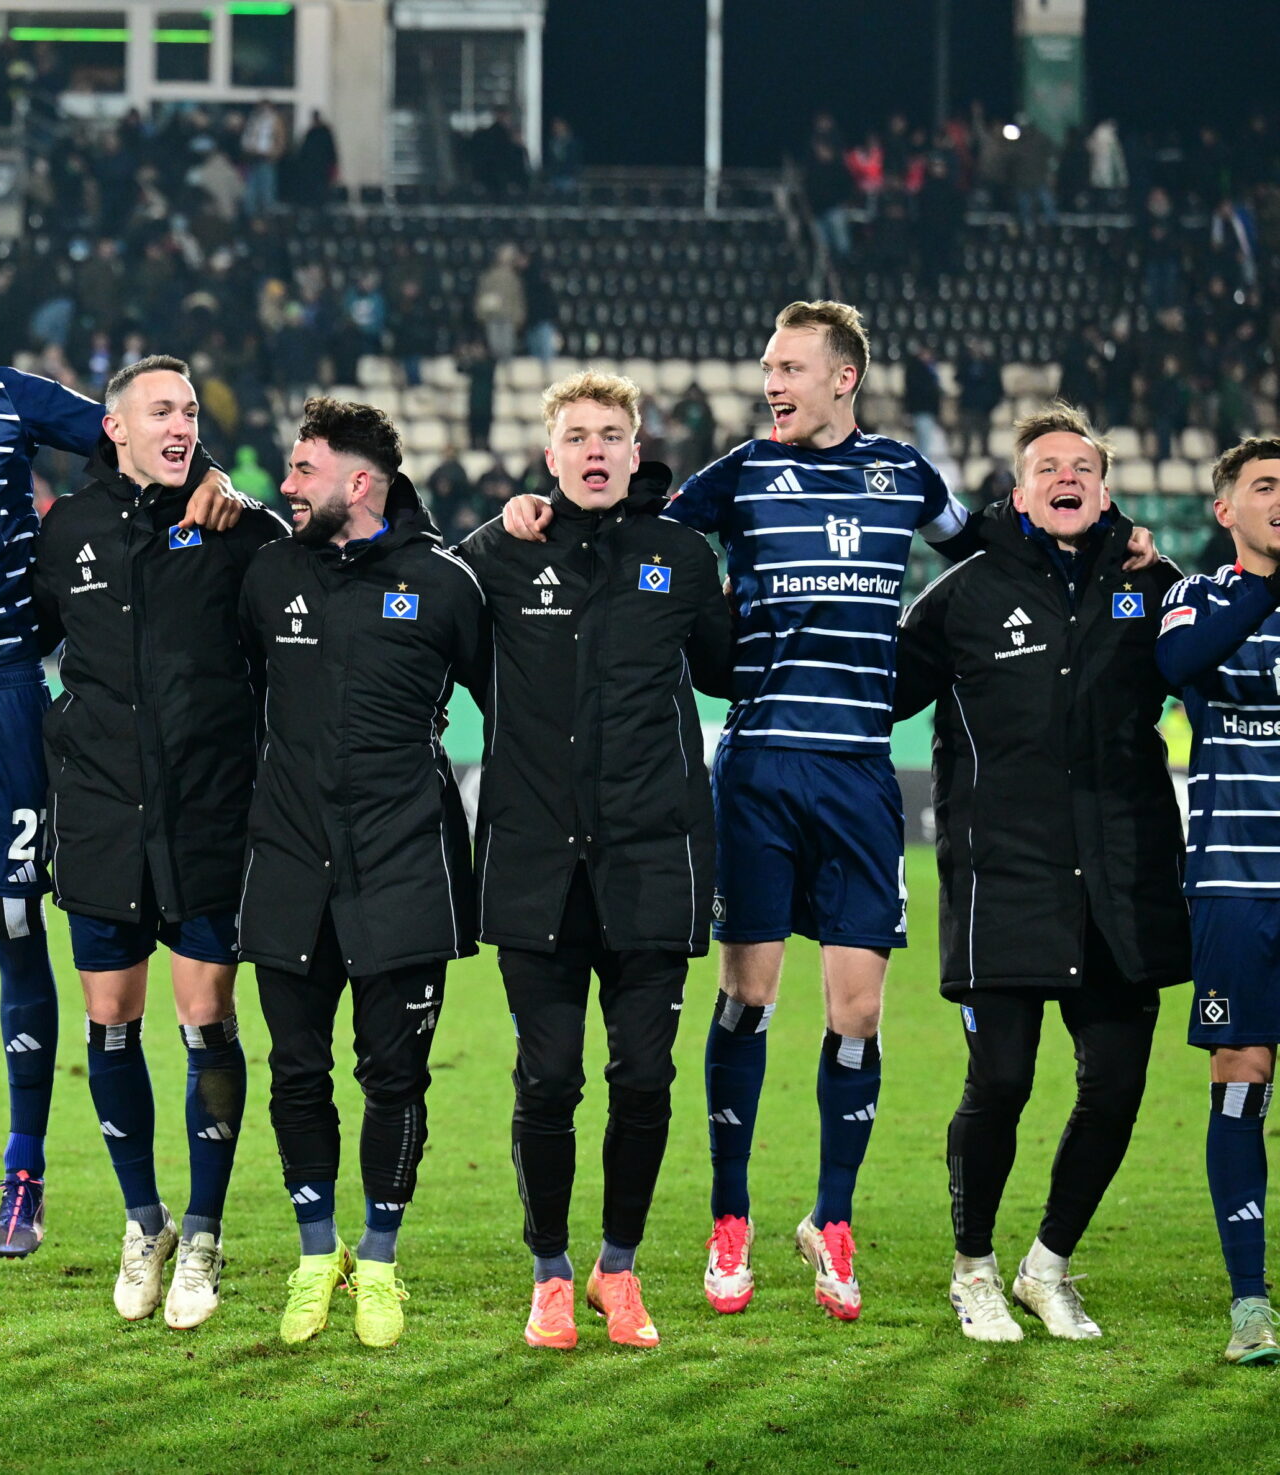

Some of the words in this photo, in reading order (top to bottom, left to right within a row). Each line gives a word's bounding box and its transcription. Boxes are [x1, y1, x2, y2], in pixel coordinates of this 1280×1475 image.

[772, 572, 900, 595] HanseMerkur
[521, 607, 573, 616] HanseMerkur
[275, 635, 318, 645] HanseMerkur
[994, 643, 1047, 660] HanseMerkur
